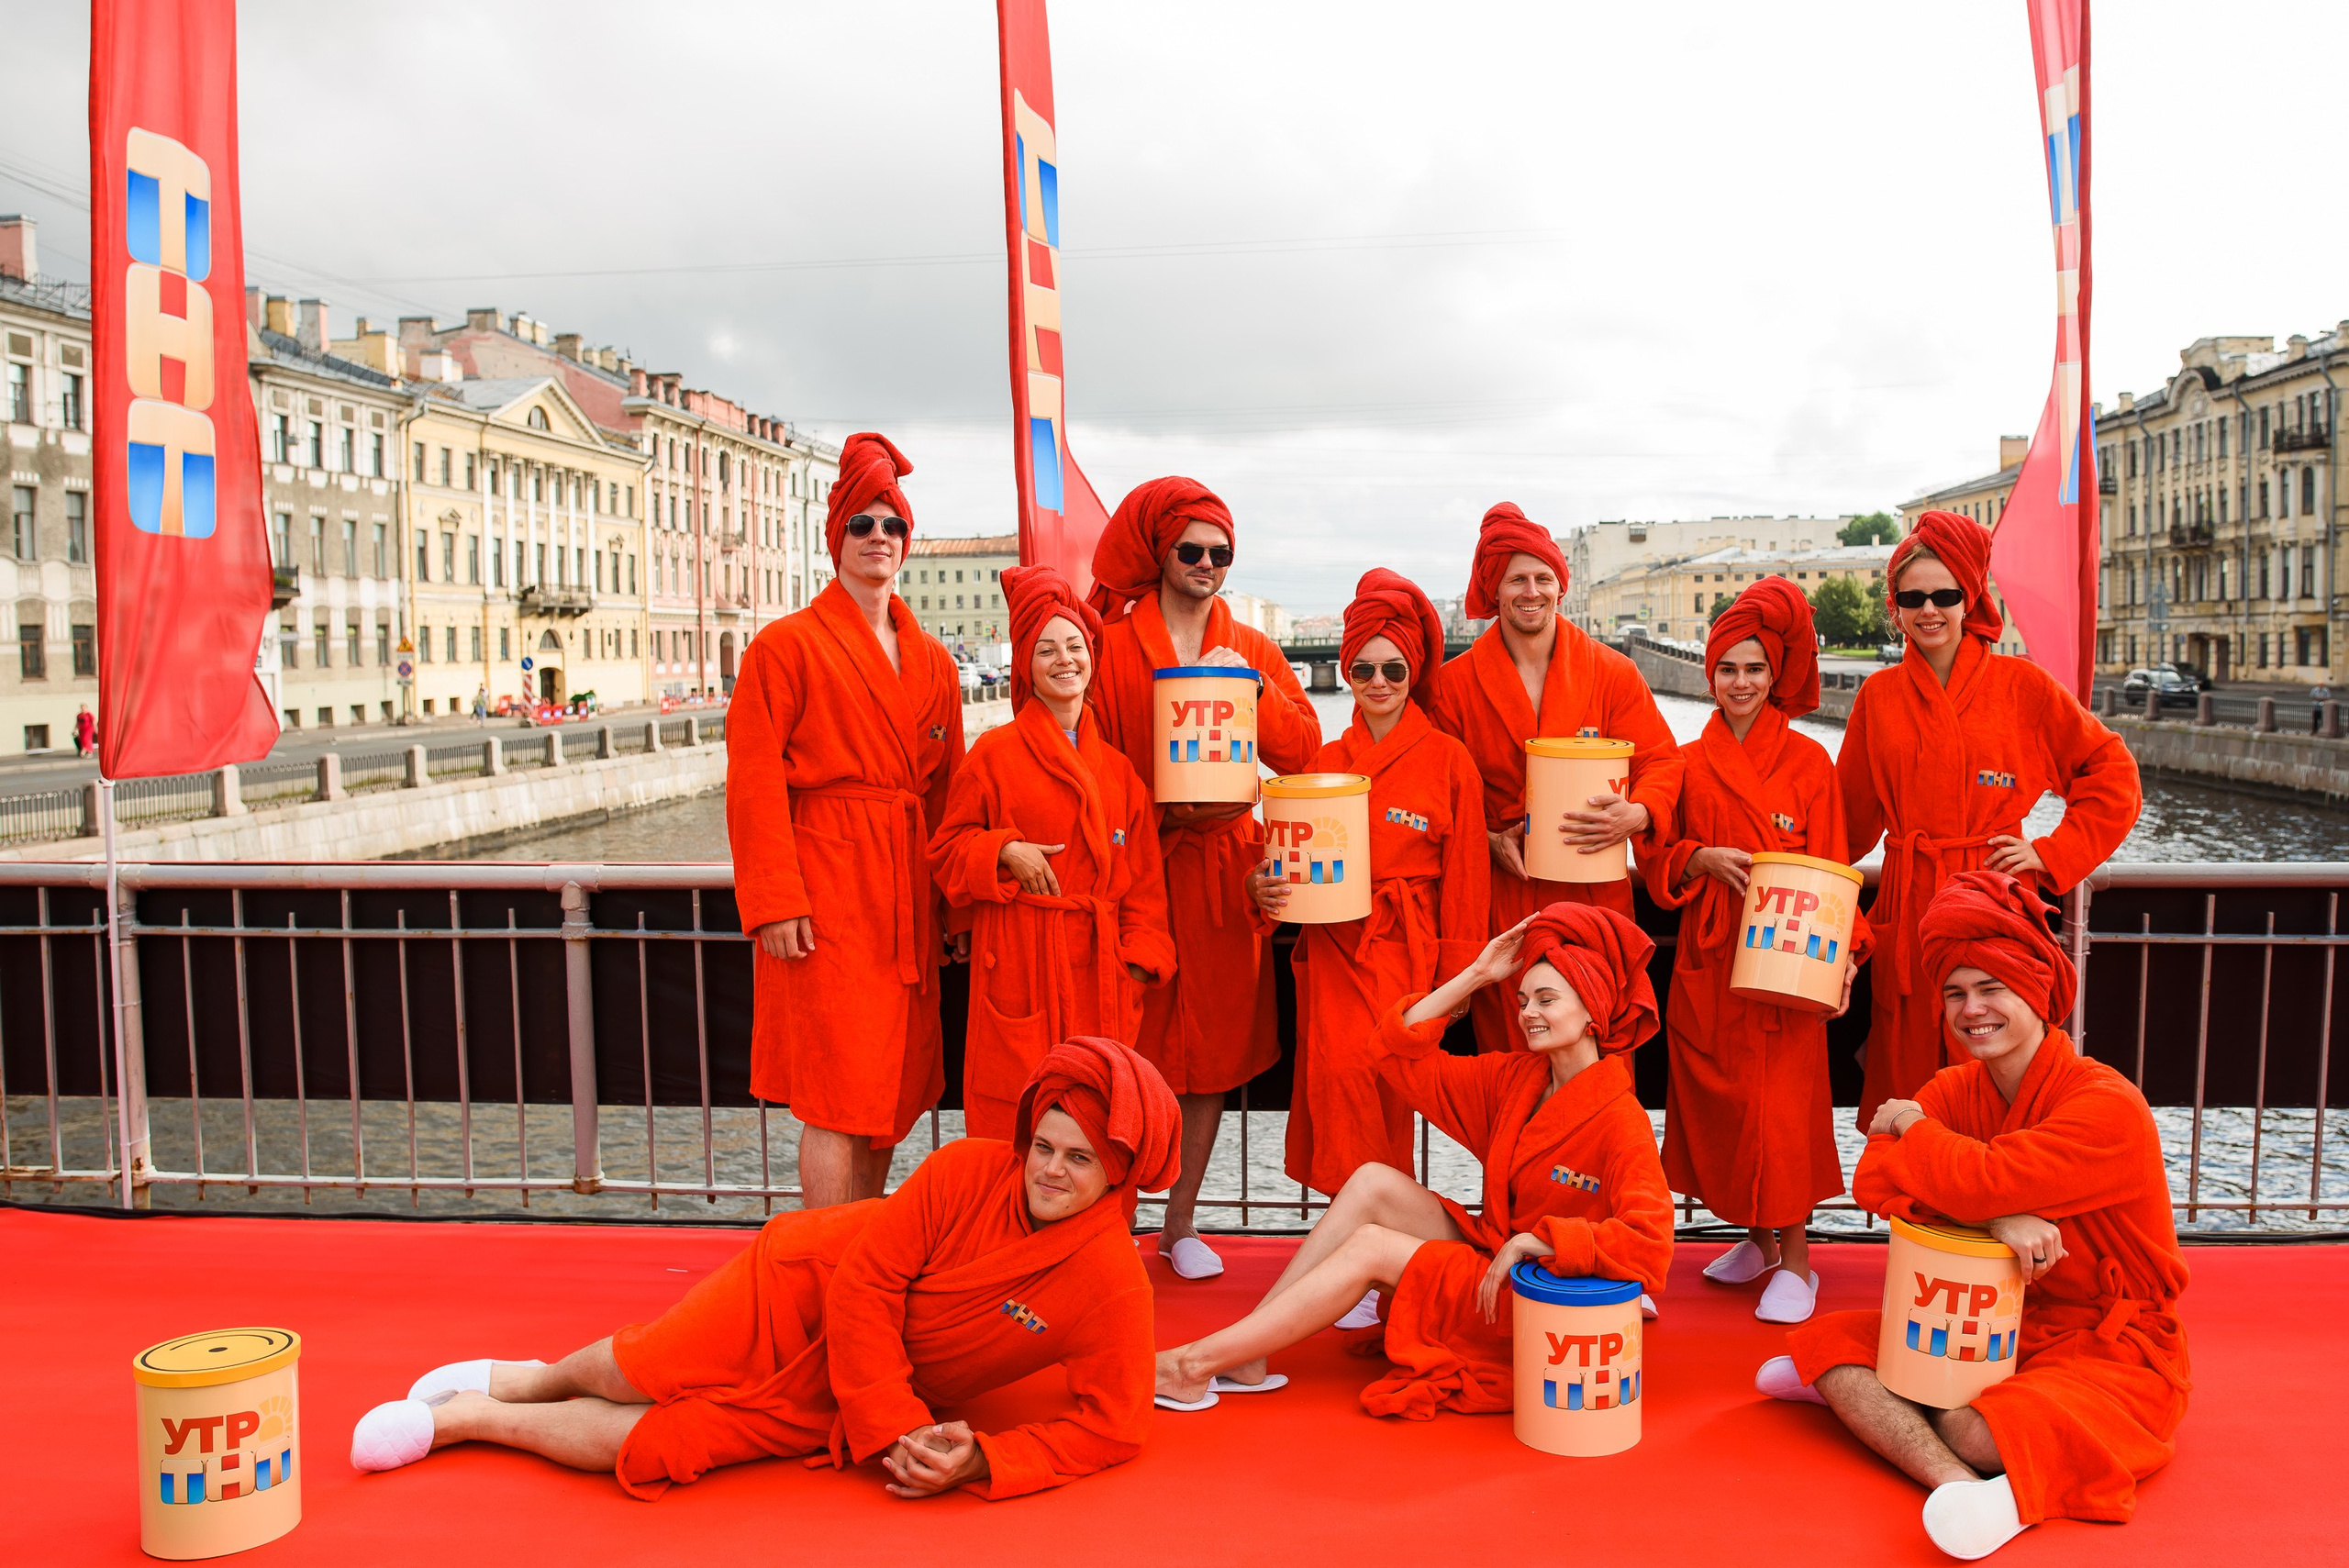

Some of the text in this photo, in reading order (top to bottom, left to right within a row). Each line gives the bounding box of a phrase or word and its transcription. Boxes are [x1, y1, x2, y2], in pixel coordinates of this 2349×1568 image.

[127, 126, 217, 539] ТНТ
[1170, 729, 1252, 763] ТНТ
[1977, 769, 2016, 788] ТНТ
[1386, 806, 1429, 832] ТНТ
[1745, 916, 1841, 964] ТНТ
[1551, 1164, 1601, 1195] ТНТ
[1000, 1298, 1049, 1335] ТНТ
[1906, 1307, 2017, 1362] ТНТ
[1543, 1358, 1641, 1411] ТНТ
[160, 1436, 292, 1505] ТНТ
